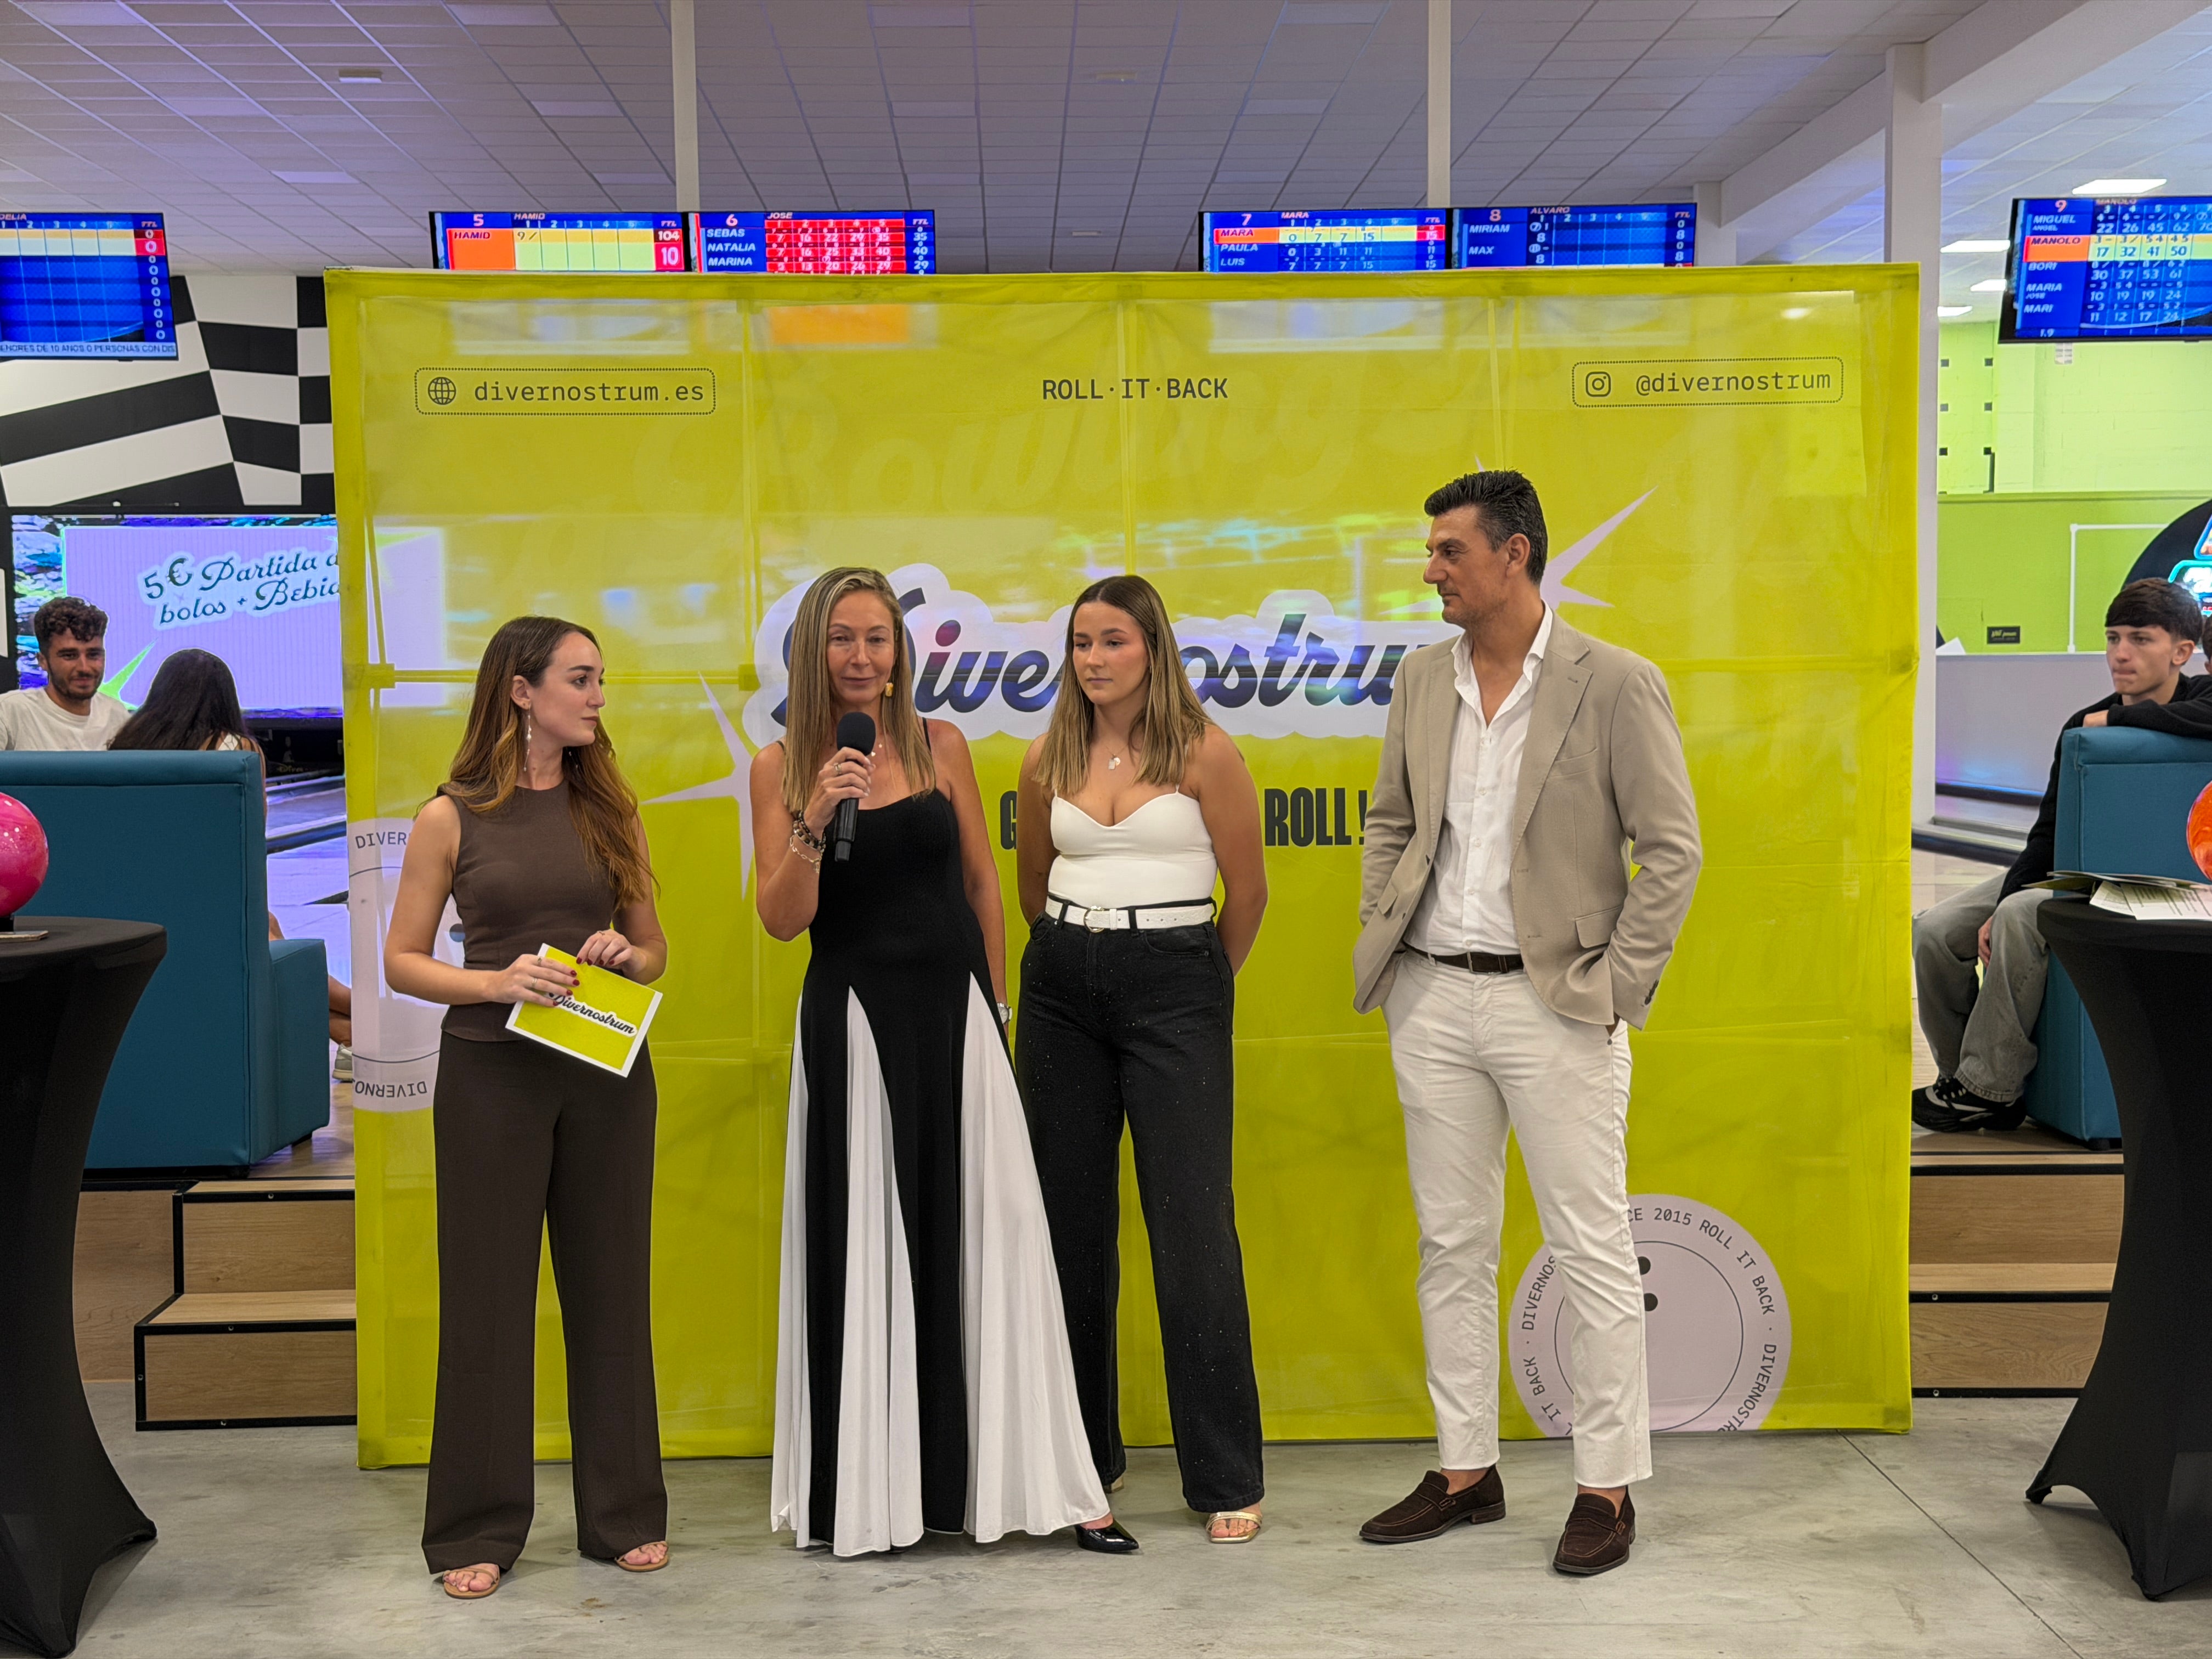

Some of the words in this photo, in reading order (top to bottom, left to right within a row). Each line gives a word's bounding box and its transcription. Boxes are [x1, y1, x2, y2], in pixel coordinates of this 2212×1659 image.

[2055, 200, 2067, 213] 9
[473, 215, 483, 226] 5
[726, 214, 738, 226] 6
[1242, 214, 1252, 225] 7
[1489, 209, 1502, 222] 8
[2033, 215, 2076, 224] MIGUEL
[26, 221, 33, 229] 2
[1469, 224, 1510, 233] MIRIAM
[2097, 223, 2114, 233] 22
[2122, 223, 2138, 233] 26
[2173, 222, 2190, 232] 62
[517, 232, 524, 241] 9
[658, 230, 680, 241] 104
[707, 228, 745, 238] SEBAS
[913, 232, 928, 241] 35
[1221, 229, 1254, 237] MARA
[1315, 233, 1322, 241] 7
[1340, 233, 1347, 241] 7
[1537, 233, 1545, 242] 8
[1676, 230, 1685, 239] 8
[145, 241, 157, 252] 0
[2032, 237, 2081, 245] MANOLO
[708, 242, 756, 252] NATALIA
[913, 247, 928, 255] 40
[1221, 243, 1259, 252] PAULA
[1288, 248, 1296, 256] 0
[1339, 247, 1347, 256] 11
[1427, 246, 1435, 254] 11
[1469, 246, 1494, 255] MAX
[2097, 247, 2109, 257] 17
[2120, 246, 2137, 257] 32
[2147, 246, 2160, 257] 41
[2170, 246, 2187, 256] 50
[662, 247, 679, 266] 10
[1536, 254, 1544, 263] 8
[1675, 251, 1684, 261] 8
[708, 257, 752, 266] MARINA
[914, 261, 929, 270] 29
[1221, 258, 1245, 266] LUIS
[1339, 261, 1347, 269] 7
[1426, 260, 1436, 268] 15
[2028, 262, 2058, 270] BORI
[149, 266, 158, 275] 0
[2091, 269, 2108, 280] 30
[2118, 269, 2134, 280] 37
[2142, 269, 2159, 280] 53
[2169, 269, 2182, 279] 61
[151, 287, 161, 297] 0
[2026, 283, 2062, 292] MARIA
[2090, 291, 2104, 301] 10
[2117, 291, 2130, 301] 19
[2142, 291, 2155, 301] 19
[2165, 290, 2181, 300] 24
[154, 308, 163, 318] 0
[2023, 303, 2054, 313] MARI
[2090, 312, 2100, 323] 11
[2114, 311, 2128, 321] 12
[2140, 311, 2152, 321] 17
[156, 330, 165, 340] 0
[94, 345, 140, 353] PERSONAS
[1636, 371, 1831, 397] @divernostrum
[475, 381, 704, 402] divernostrum.es
[199, 552, 317, 591] Partida
[160, 598, 227, 625] bolos
[1264, 787, 1367, 847] ROLL!
[352, 1078, 427, 1098] DIVERNO
[1654, 1207, 1692, 1226] 2015
[1699, 1219, 1734, 1250] ROLL
[1736, 1250, 1757, 1269] IT
[1752, 1275, 1775, 1315] BACK
[1523, 1356, 1545, 1396] BACK
[1717, 1343, 1777, 1432] DIVERNOSTR
[1541, 1403, 1561, 1421] IT
